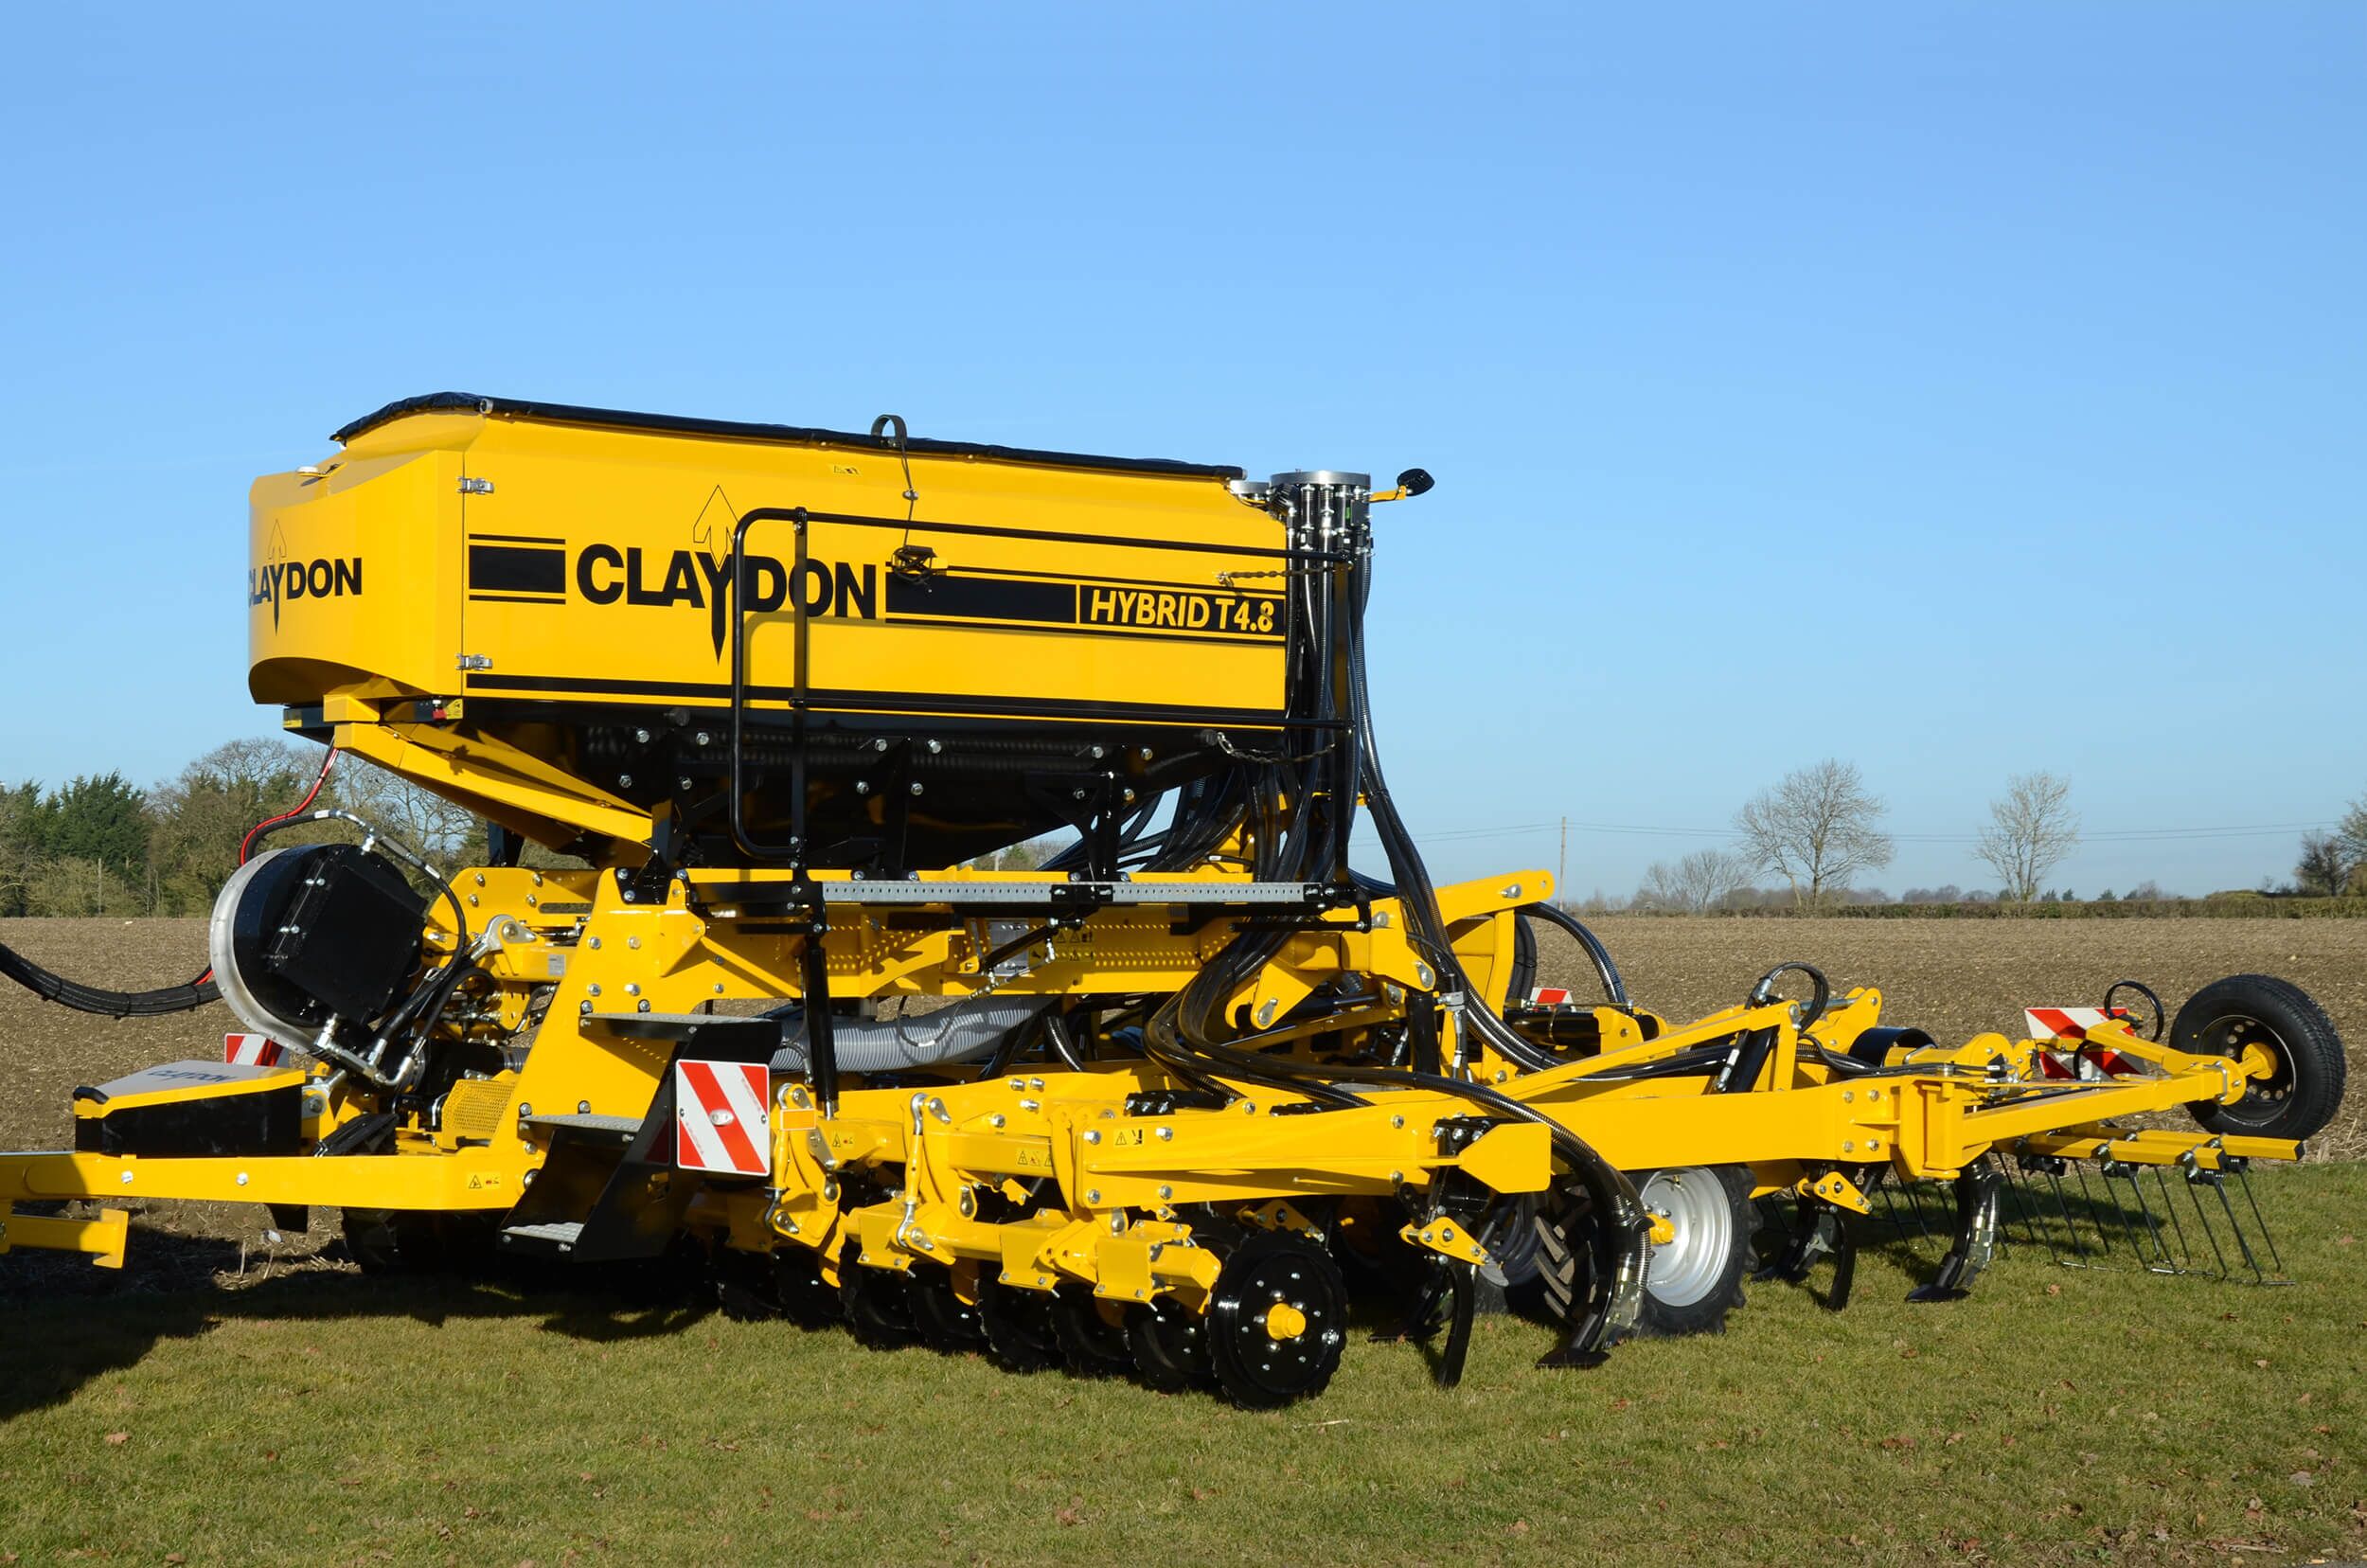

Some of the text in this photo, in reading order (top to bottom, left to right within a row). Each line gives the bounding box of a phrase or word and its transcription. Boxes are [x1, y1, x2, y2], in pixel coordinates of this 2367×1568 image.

[248, 556, 364, 637] LAYDON
[576, 543, 878, 667] CLAYDON
[1090, 589, 1275, 633] HYBRID T4.8
